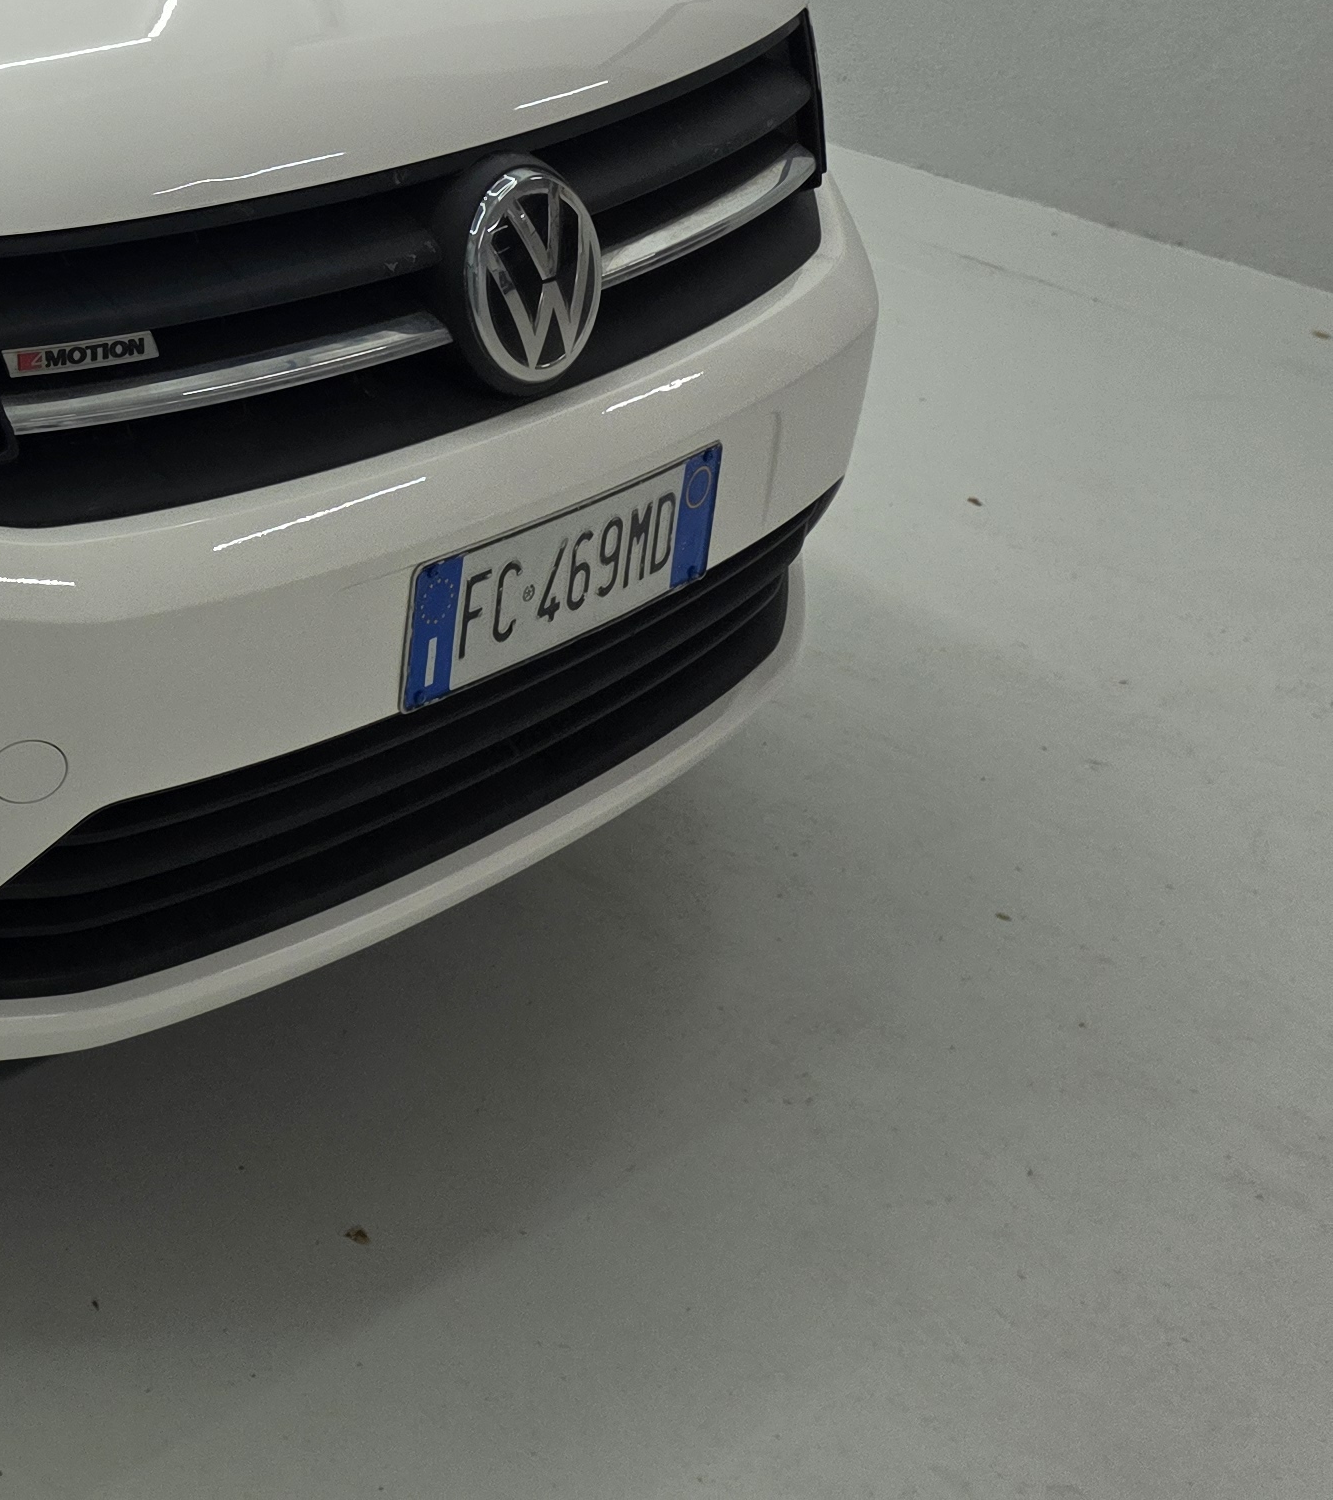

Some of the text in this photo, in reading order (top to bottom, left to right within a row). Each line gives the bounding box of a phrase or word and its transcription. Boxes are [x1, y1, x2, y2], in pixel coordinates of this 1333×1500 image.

[457, 492, 677, 661] FC 469MD
[424, 637, 437, 687] I
